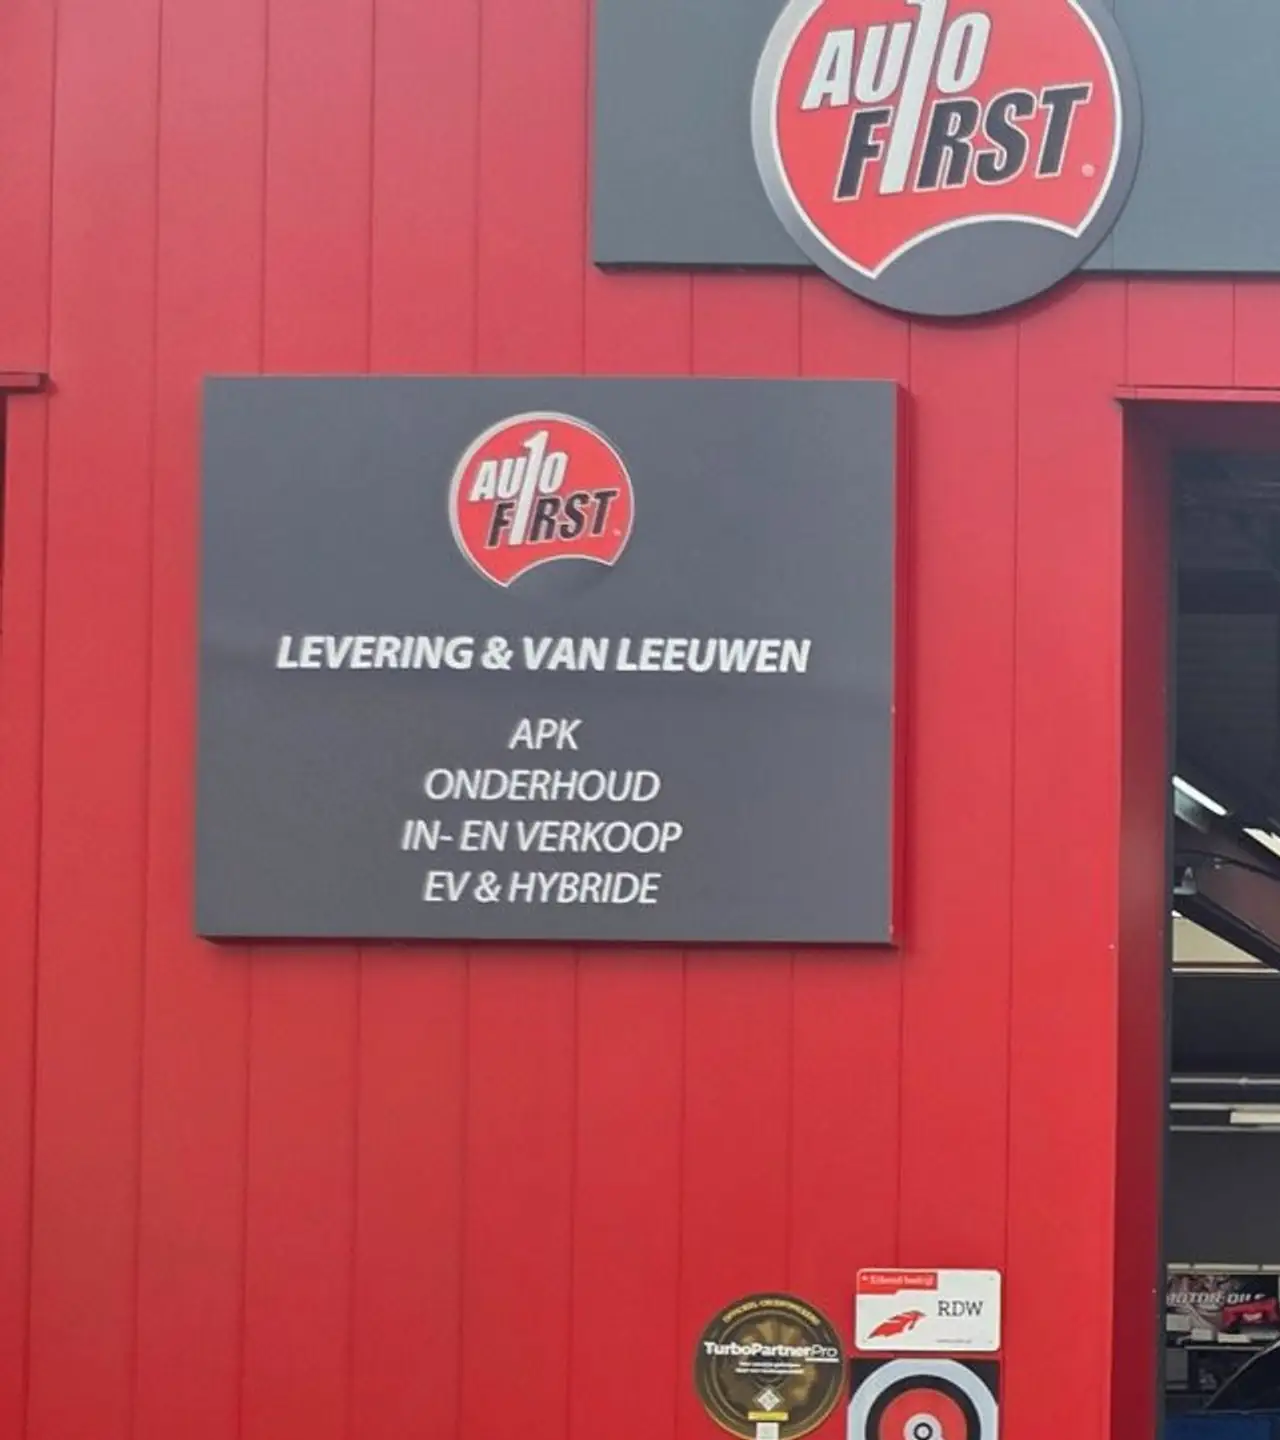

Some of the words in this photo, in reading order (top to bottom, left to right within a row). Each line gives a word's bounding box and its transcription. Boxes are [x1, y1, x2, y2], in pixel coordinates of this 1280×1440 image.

[276, 635, 475, 670] LEVERING
[481, 635, 514, 670] &
[522, 636, 610, 671] VAN
[615, 637, 812, 673] LEEUWEN
[508, 718, 583, 750] APK
[424, 768, 661, 802] ONDERHOUD
[402, 819, 453, 851] IN-
[459, 819, 509, 852] EN
[516, 820, 683, 853] VERKOOP
[423, 870, 471, 902] EV
[473, 871, 502, 903] &
[508, 871, 662, 904] HYBRIDE
[937, 1300, 984, 1318] RDW
